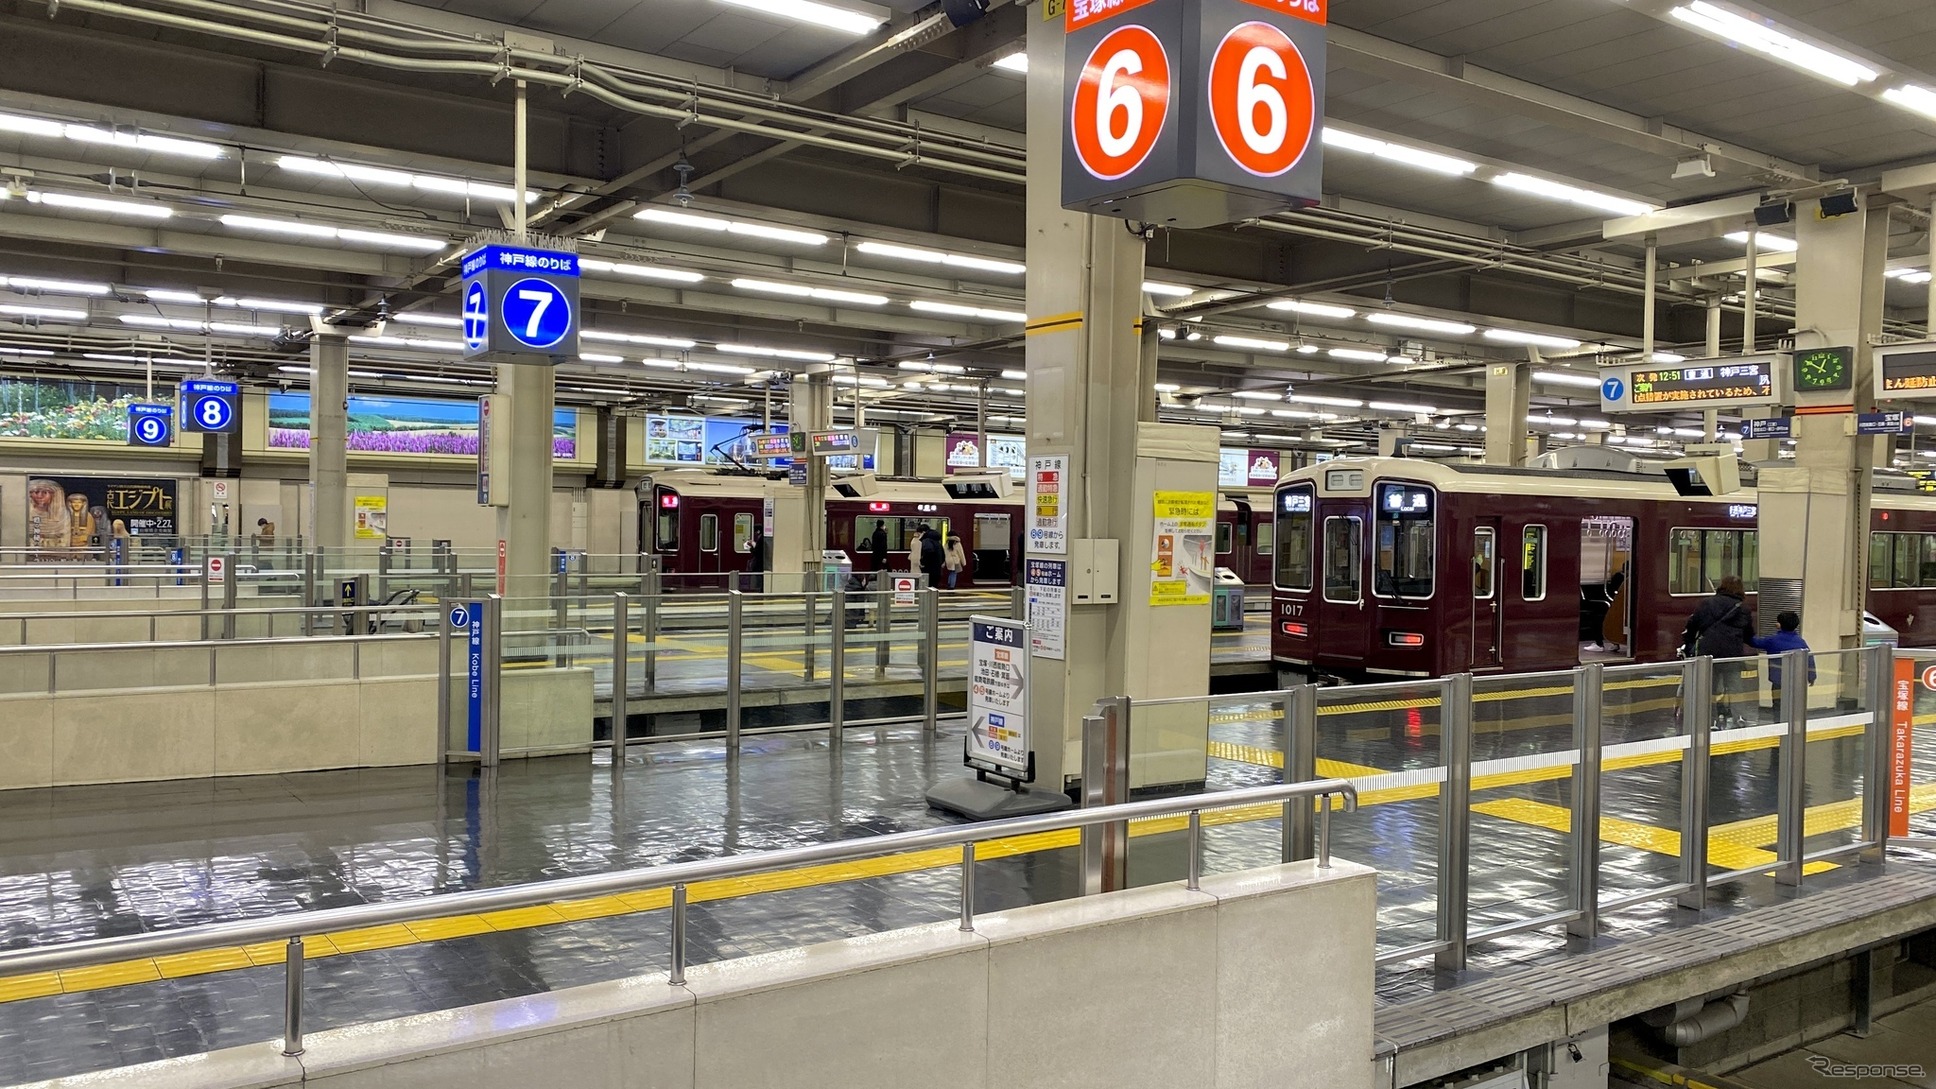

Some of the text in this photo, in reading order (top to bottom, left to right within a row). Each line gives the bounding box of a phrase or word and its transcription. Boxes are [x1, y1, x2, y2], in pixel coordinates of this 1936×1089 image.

[1096, 49, 1143, 157] 6
[1237, 46, 1287, 154] 6
[500, 252, 571, 271] 神戸線のりば
[519, 290, 553, 338] 7
[1659, 371, 1681, 381] 12:51
[1720, 365, 1759, 378] 神戸三宮
[193, 384, 232, 392] 神戸線のりば
[1607, 381, 1619, 398] 7
[203, 401, 222, 425] 8
[143, 420, 159, 440] 9
[1035, 459, 1062, 470] 神戸線
[1388, 493, 1427, 508] 普通
[1168, 507, 1199, 516] 緊急時には
[455, 610, 465, 625] 7
[1281, 603, 1304, 616] 1017
[471, 620, 480, 645] 神戸線
[986, 625, 1013, 643] ご案内
[471, 653, 480, 699] Kobe Line
[1896, 680, 1910, 711] 宝塚線
[1894, 721, 1909, 814] Takarazuka Line
